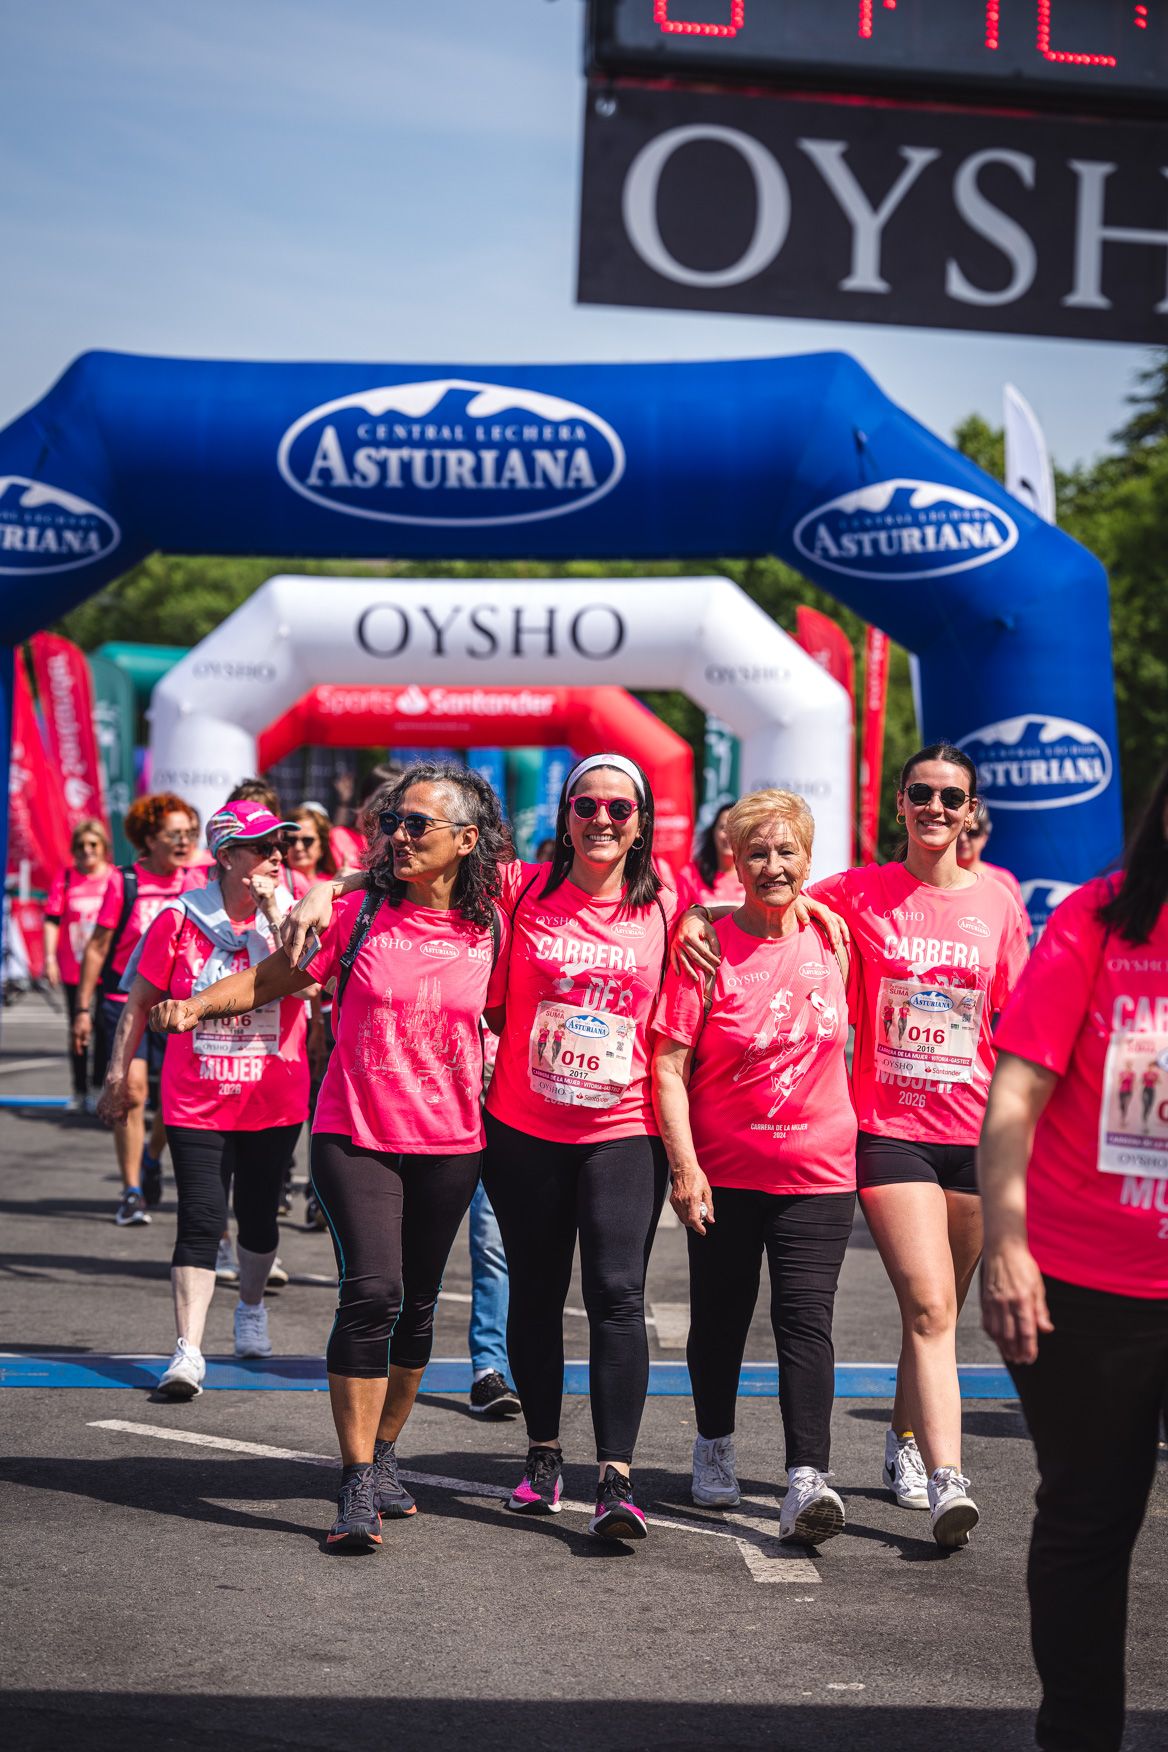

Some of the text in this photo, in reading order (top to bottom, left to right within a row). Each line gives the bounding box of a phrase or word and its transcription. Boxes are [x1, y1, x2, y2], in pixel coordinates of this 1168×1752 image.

[622, 124, 1168, 312] OYSH
[357, 424, 587, 441] CENTRAL LECHERA
[306, 425, 597, 489] ASTURIANA
[0, 522, 101, 553] RIANA
[814, 521, 1003, 558] ASTURIANA
[355, 602, 627, 660] OYSHO
[316, 685, 555, 716] Sports Santander
[536, 915, 578, 926] OYSHO
[883, 909, 925, 922] OYSHO
[536, 936, 637, 973] CARRERA
[883, 935, 980, 971] CARRERA
[727, 970, 770, 988] OYSHO
[913, 997, 950, 1008] ASTURIANA
[568, 1019, 606, 1035] ASTURIANA
[908, 1026, 945, 1044] 016
[917, 1045, 935, 1053] 2018
[199, 1056, 263, 1082] MUJER
[561, 1050, 600, 1071] 016
[883, 1059, 913, 1071] OYSHO
[569, 1070, 588, 1079] 2017
[932, 1068, 961, 1076] Santander
[539, 1081, 566, 1096] OYSHO
[898, 1090, 926, 1108] 2026
